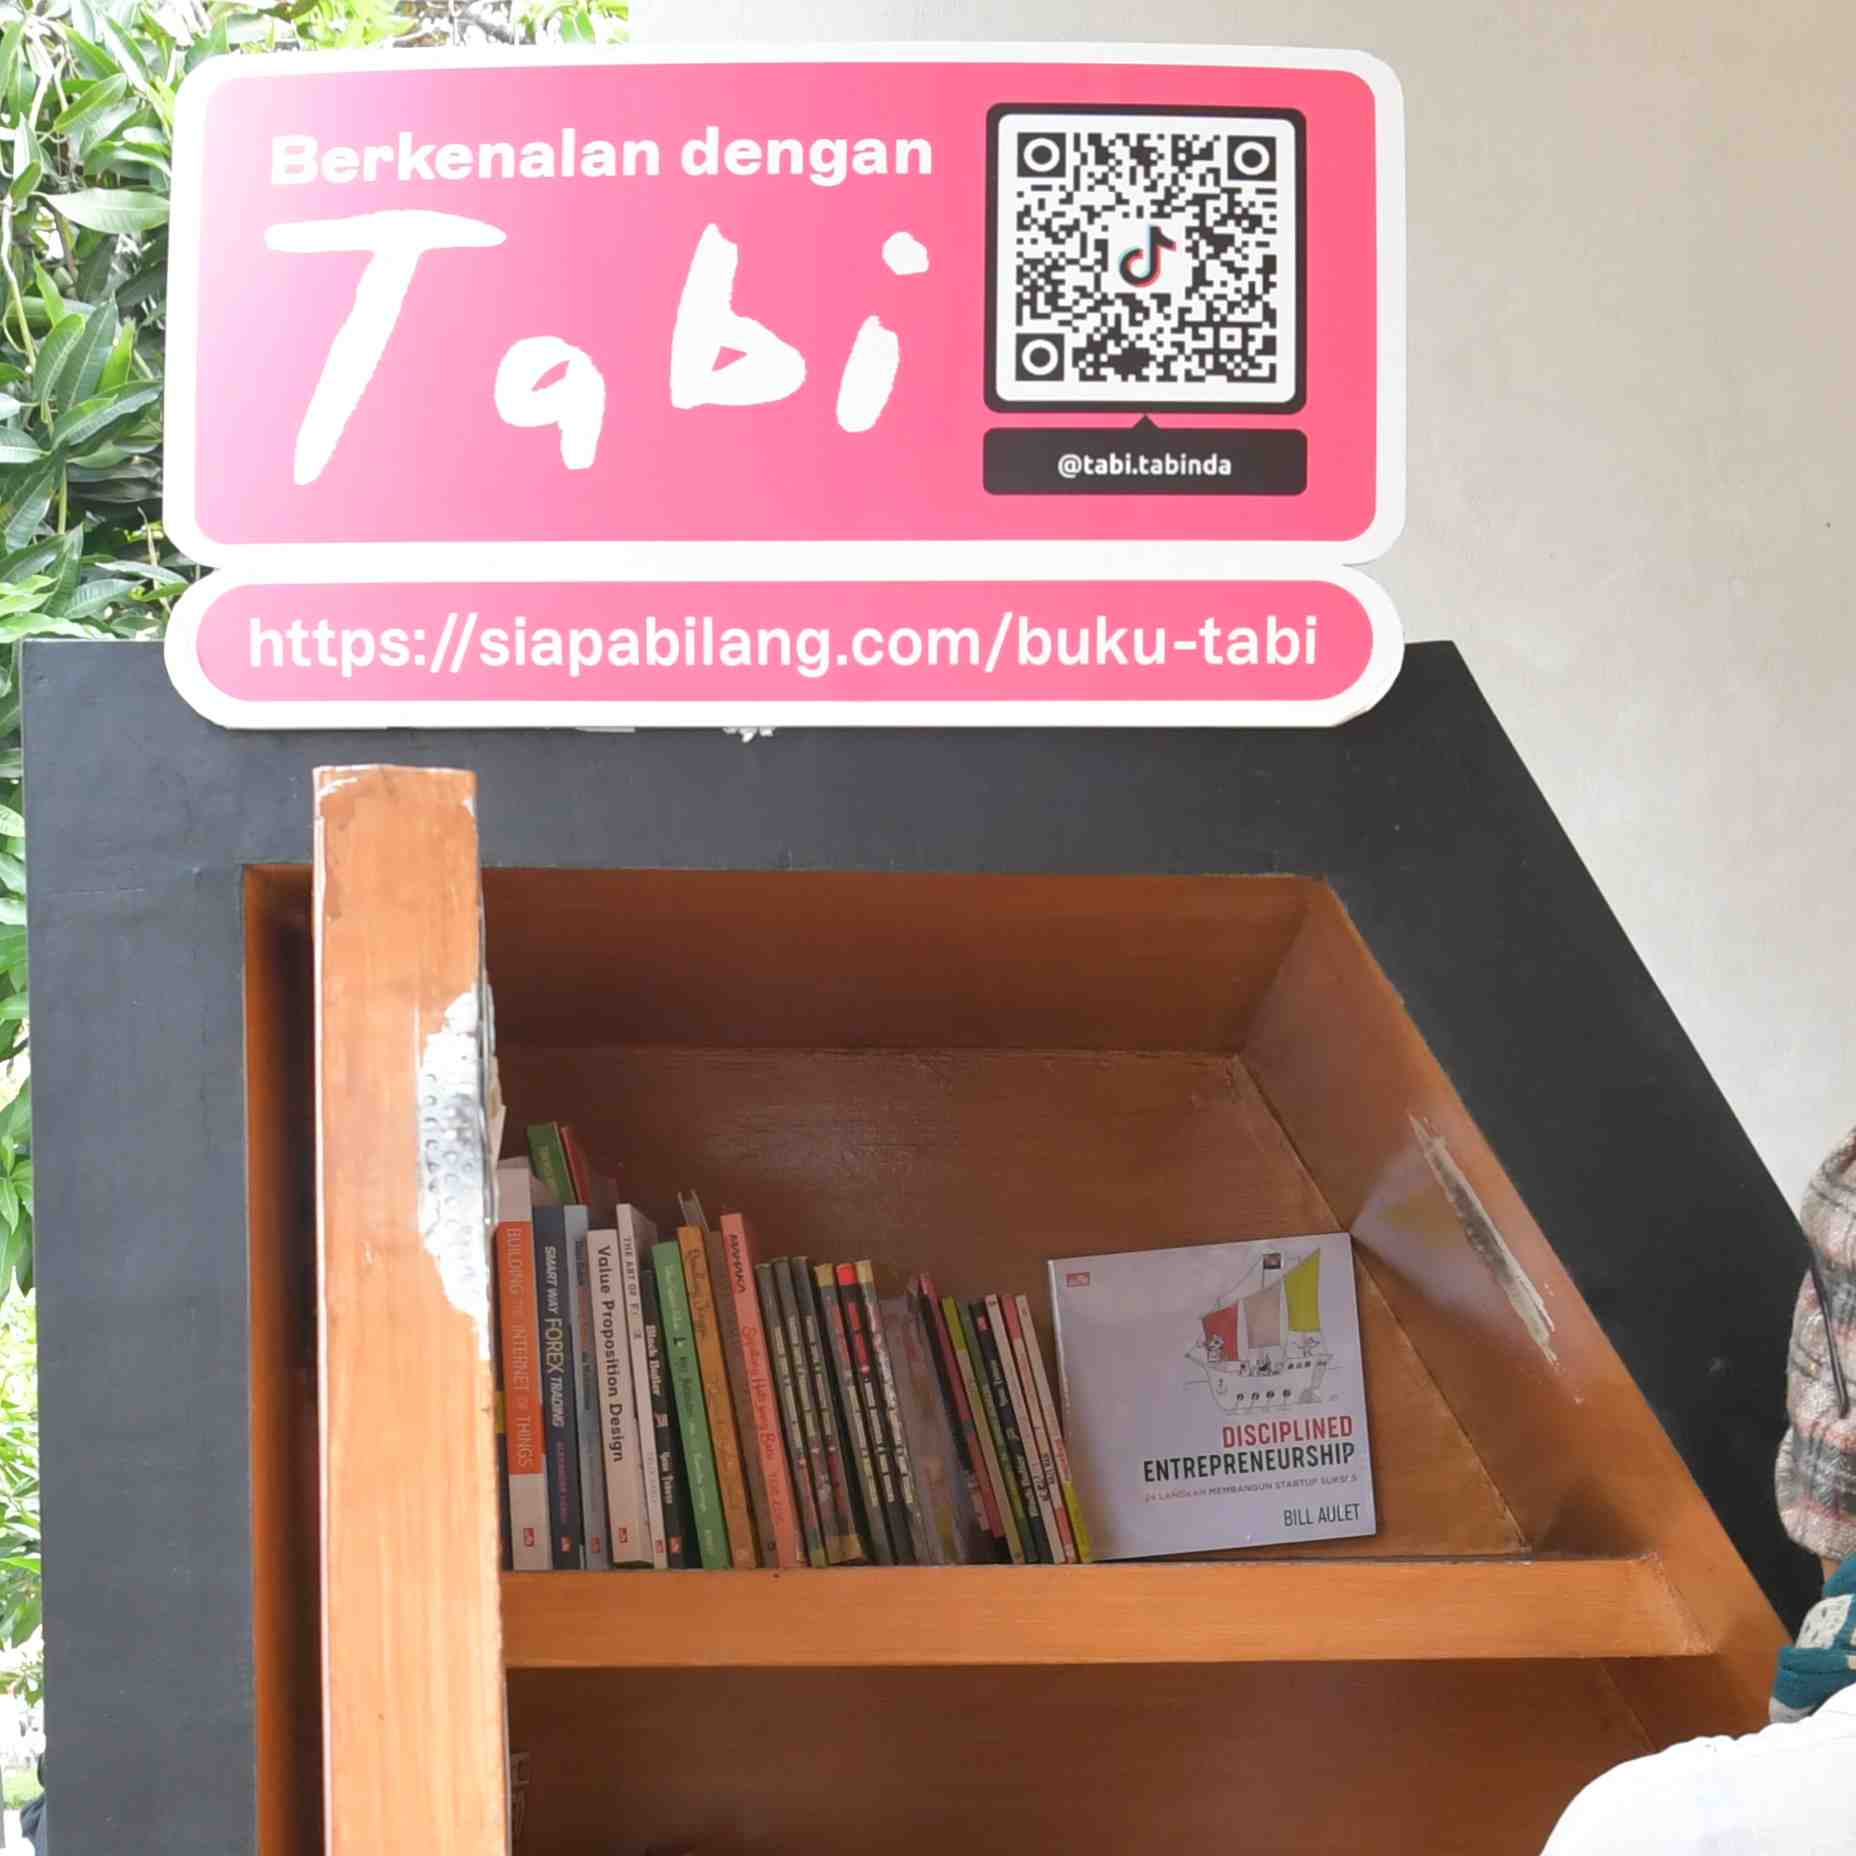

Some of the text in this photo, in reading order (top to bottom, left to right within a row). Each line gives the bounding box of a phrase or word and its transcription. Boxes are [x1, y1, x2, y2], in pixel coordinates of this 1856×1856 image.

[269, 124, 934, 191] Berkenalan dengan
[263, 208, 930, 486] Tabi
[1056, 450, 1233, 481] @tabi.tabinda
[248, 611, 1318, 677] https://siapabilang.com/buku-tabi
[506, 1227, 524, 1297] BUILDING
[511, 1325, 530, 1392] INTERNET
[544, 1245, 565, 1428] SMART WAY FOREX TRADING
[596, 1245, 625, 1463] Value Proposition Design
[515, 1414, 534, 1469] THINGS
[1143, 1442, 1356, 1483] ENTREPRENEURSHIP
[1222, 1415, 1353, 1449] DISCIPLINED
[1208, 1482, 1273, 1497] MEMBANGUN
[1275, 1476, 1319, 1490] STARTUP
[1283, 1503, 1361, 1528] BILL AULET
